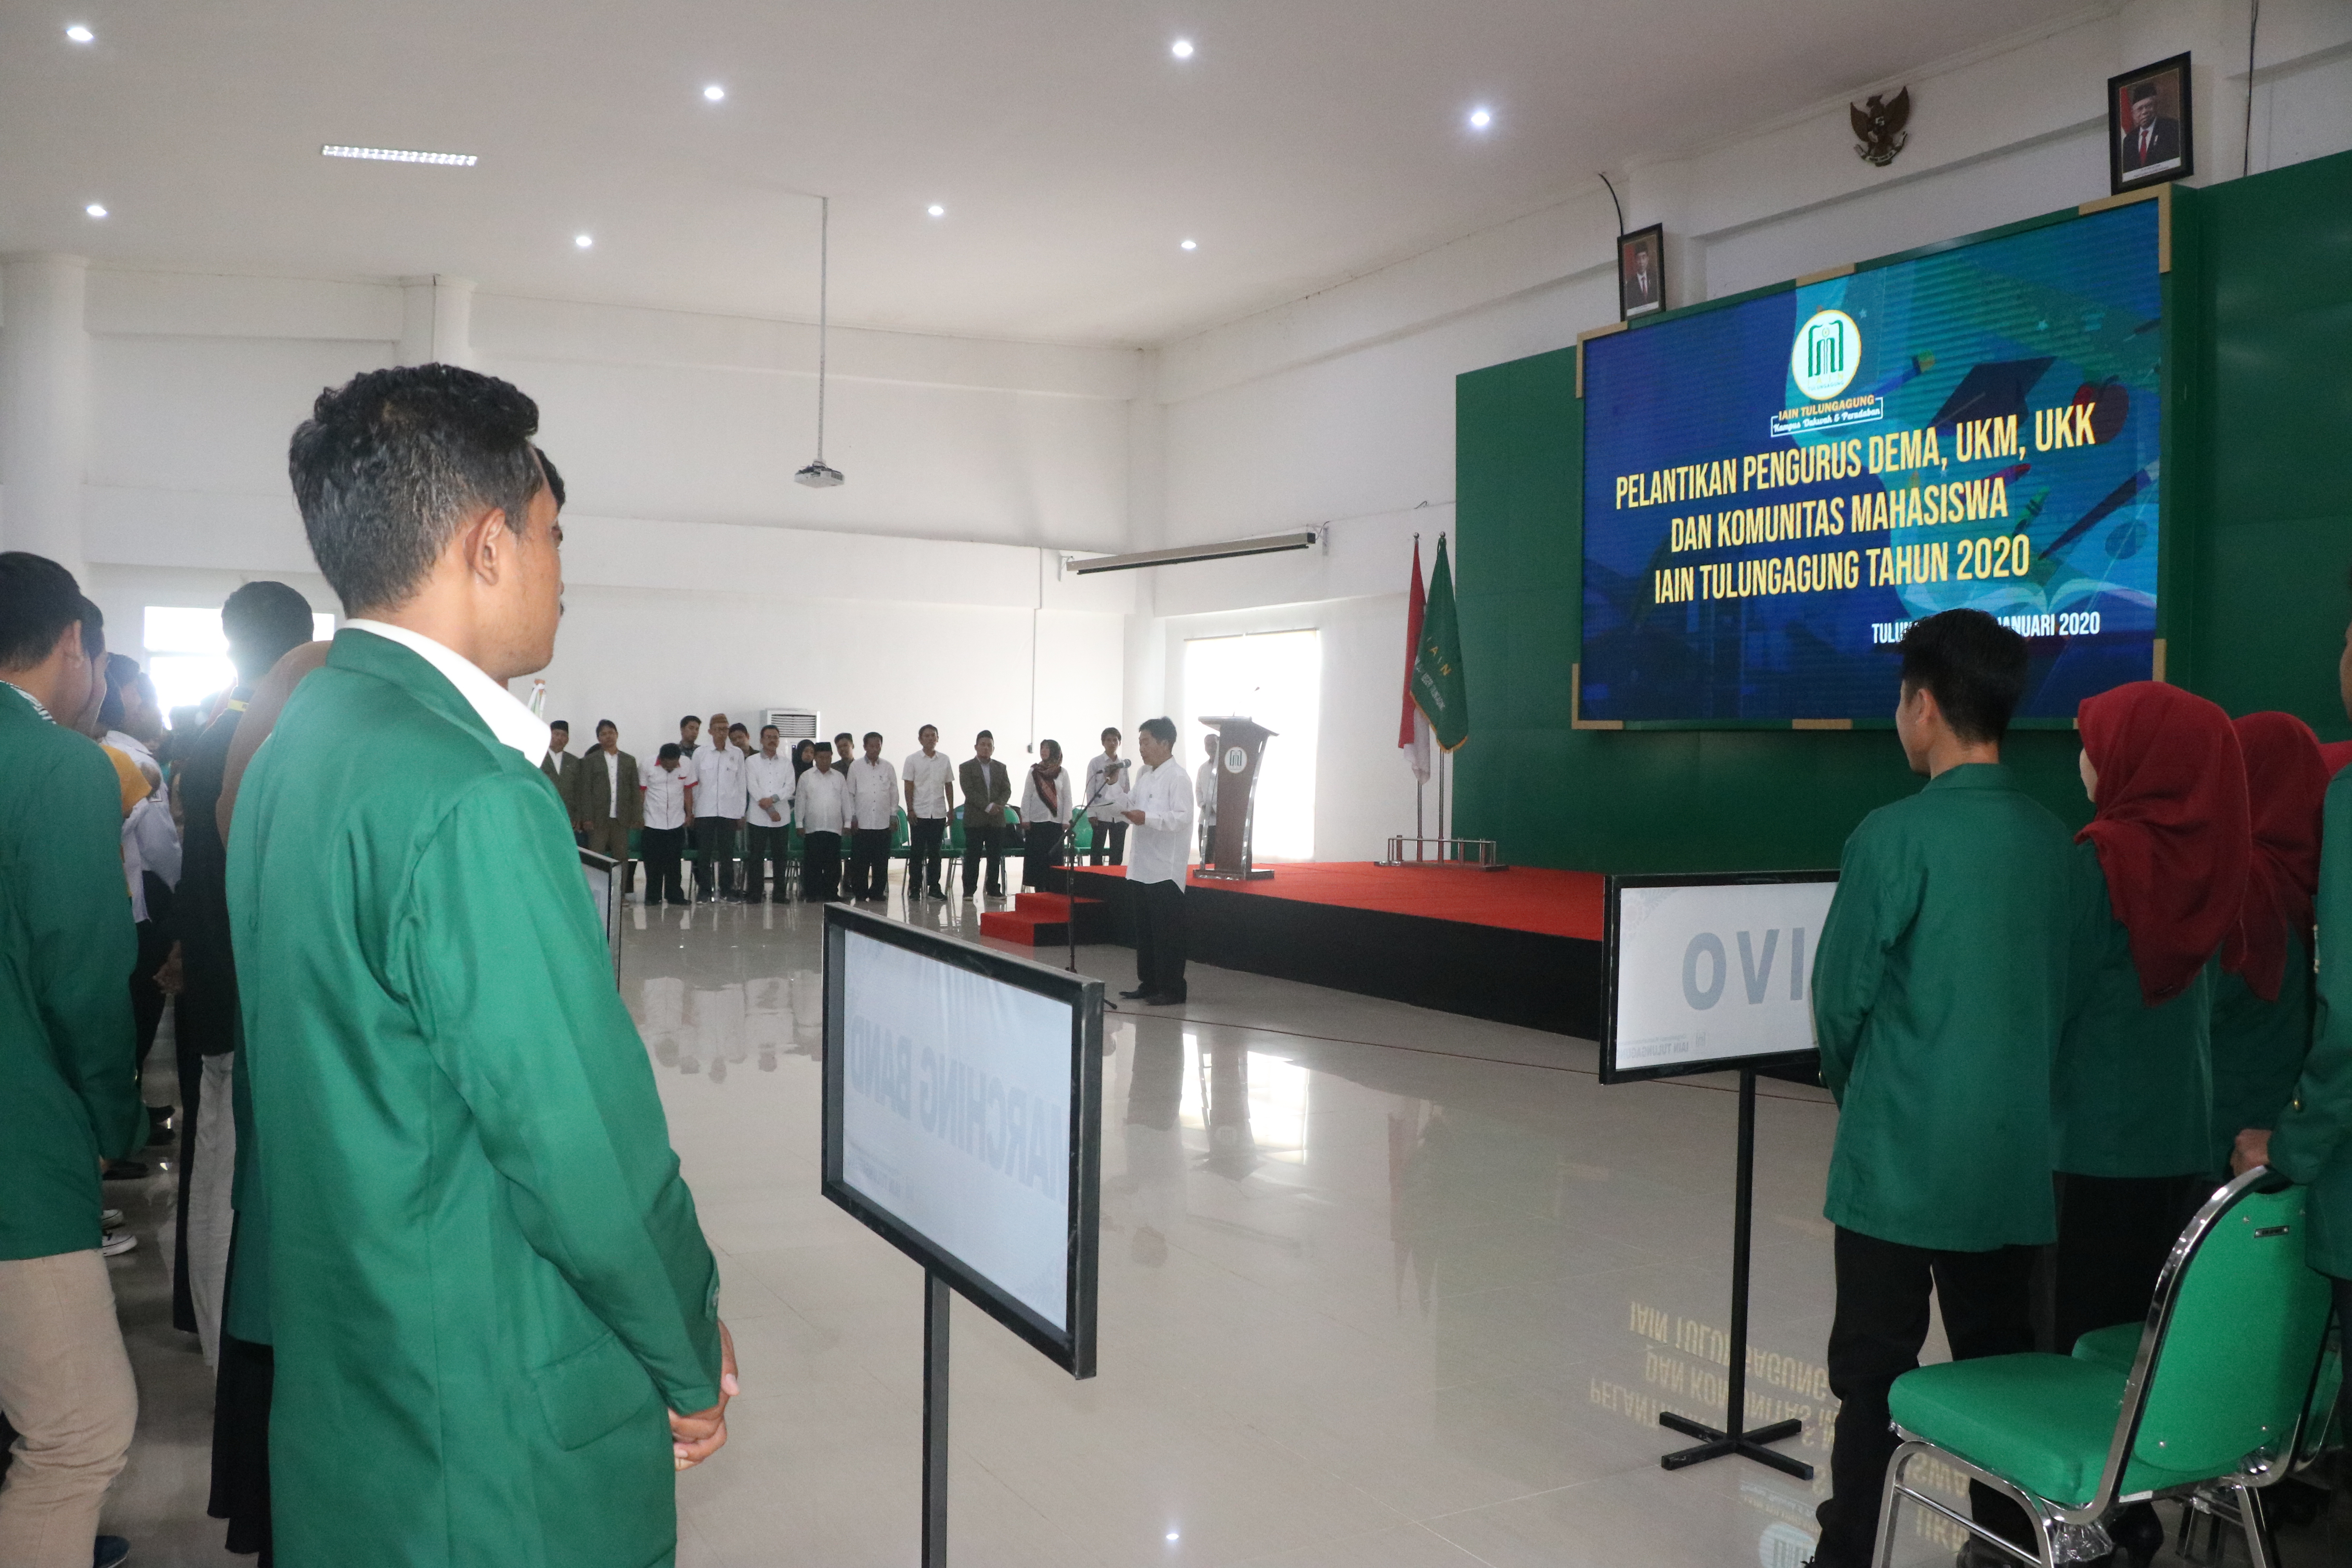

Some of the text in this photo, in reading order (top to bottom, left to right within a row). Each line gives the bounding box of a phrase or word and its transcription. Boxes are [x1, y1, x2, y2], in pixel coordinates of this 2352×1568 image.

[1773, 421, 1801, 432] Kampus
[1802, 415, 1833, 427] Dakwah
[1841, 408, 1880, 421] Peradaban
[1779, 394, 1875, 421] IAIN TULUNGAGUNG
[1616, 402, 2096, 510] PELANTIKAN PENGURUS DEMA, UKM, UKK
[1671, 477, 2009, 553] DAN KOMUNITAS MAHASISWA
[1655, 534, 2030, 604] IAIN TULUNGAGUNG TAHUN 2020
[2059, 612, 2101, 636] 2020
